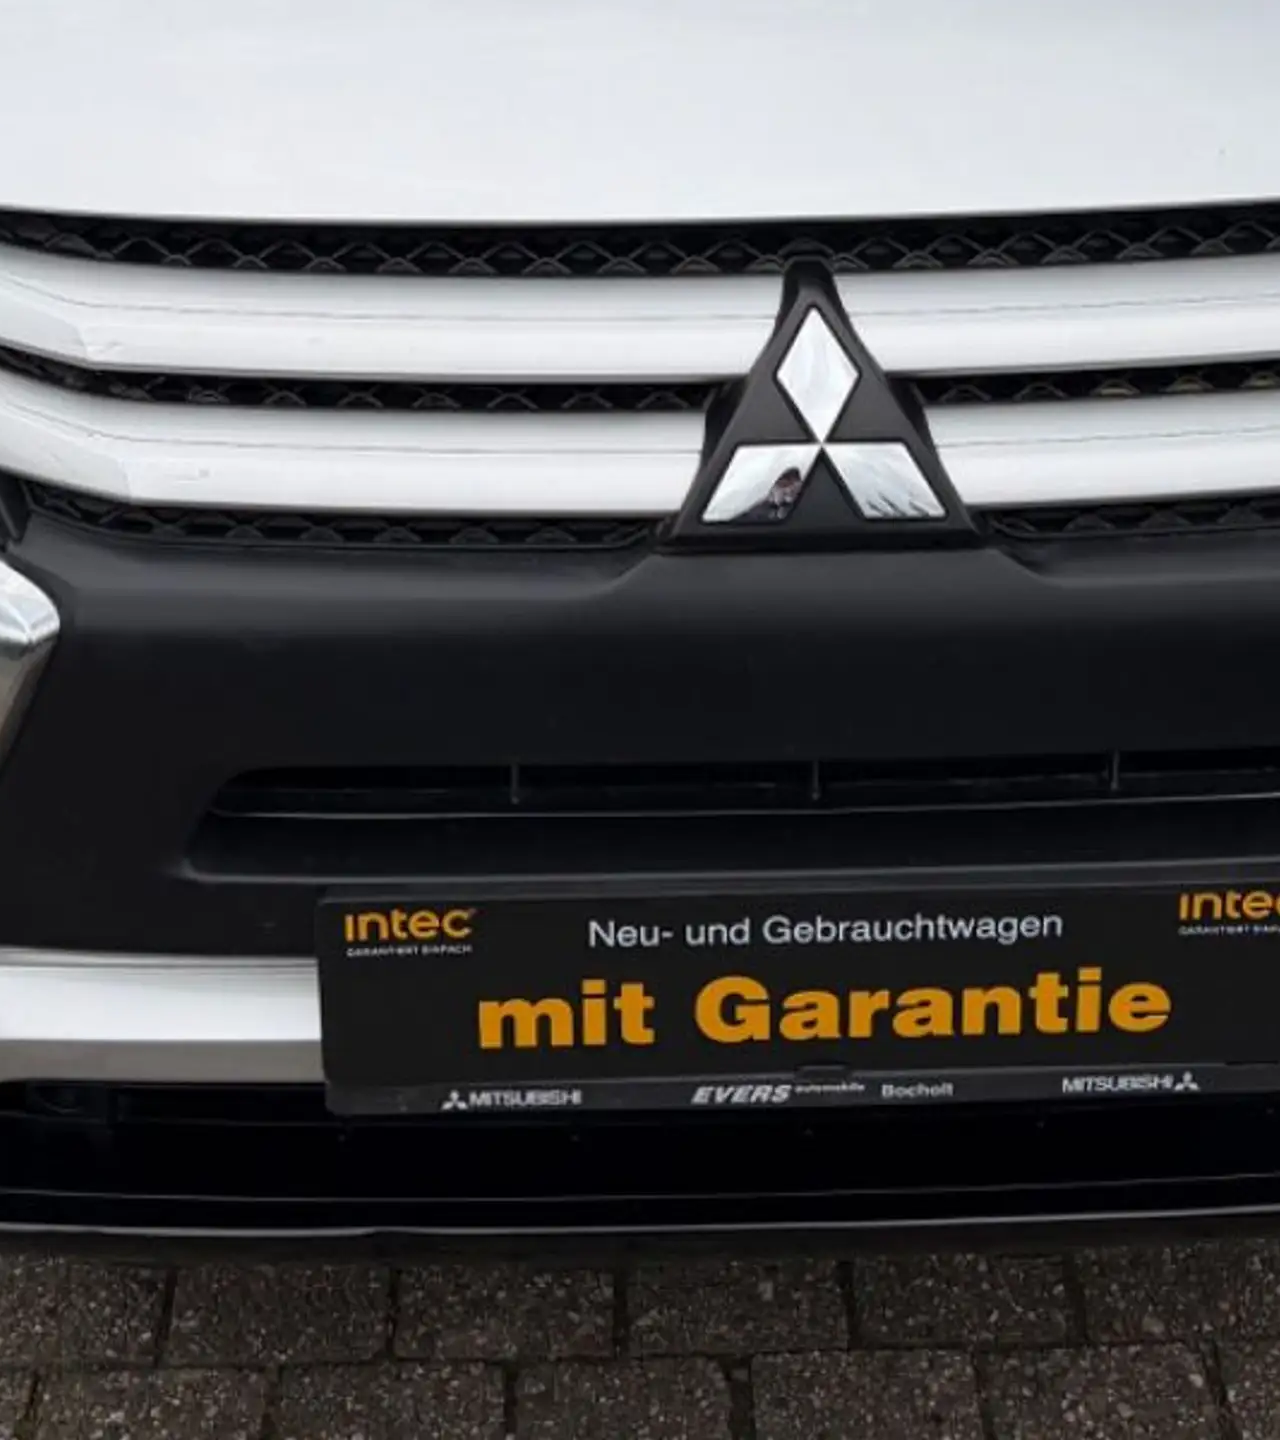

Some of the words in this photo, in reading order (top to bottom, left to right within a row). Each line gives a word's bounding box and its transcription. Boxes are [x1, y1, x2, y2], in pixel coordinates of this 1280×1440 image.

[344, 908, 473, 943] intec
[588, 919, 674, 948] Neu-
[685, 917, 750, 946] und
[762, 912, 1063, 946] Gebrauchtwagen
[478, 979, 655, 1049] mit
[694, 967, 1172, 1043] Garantie
[690, 1084, 792, 1105] EVERS
[881, 1081, 954, 1098] Bocholt
